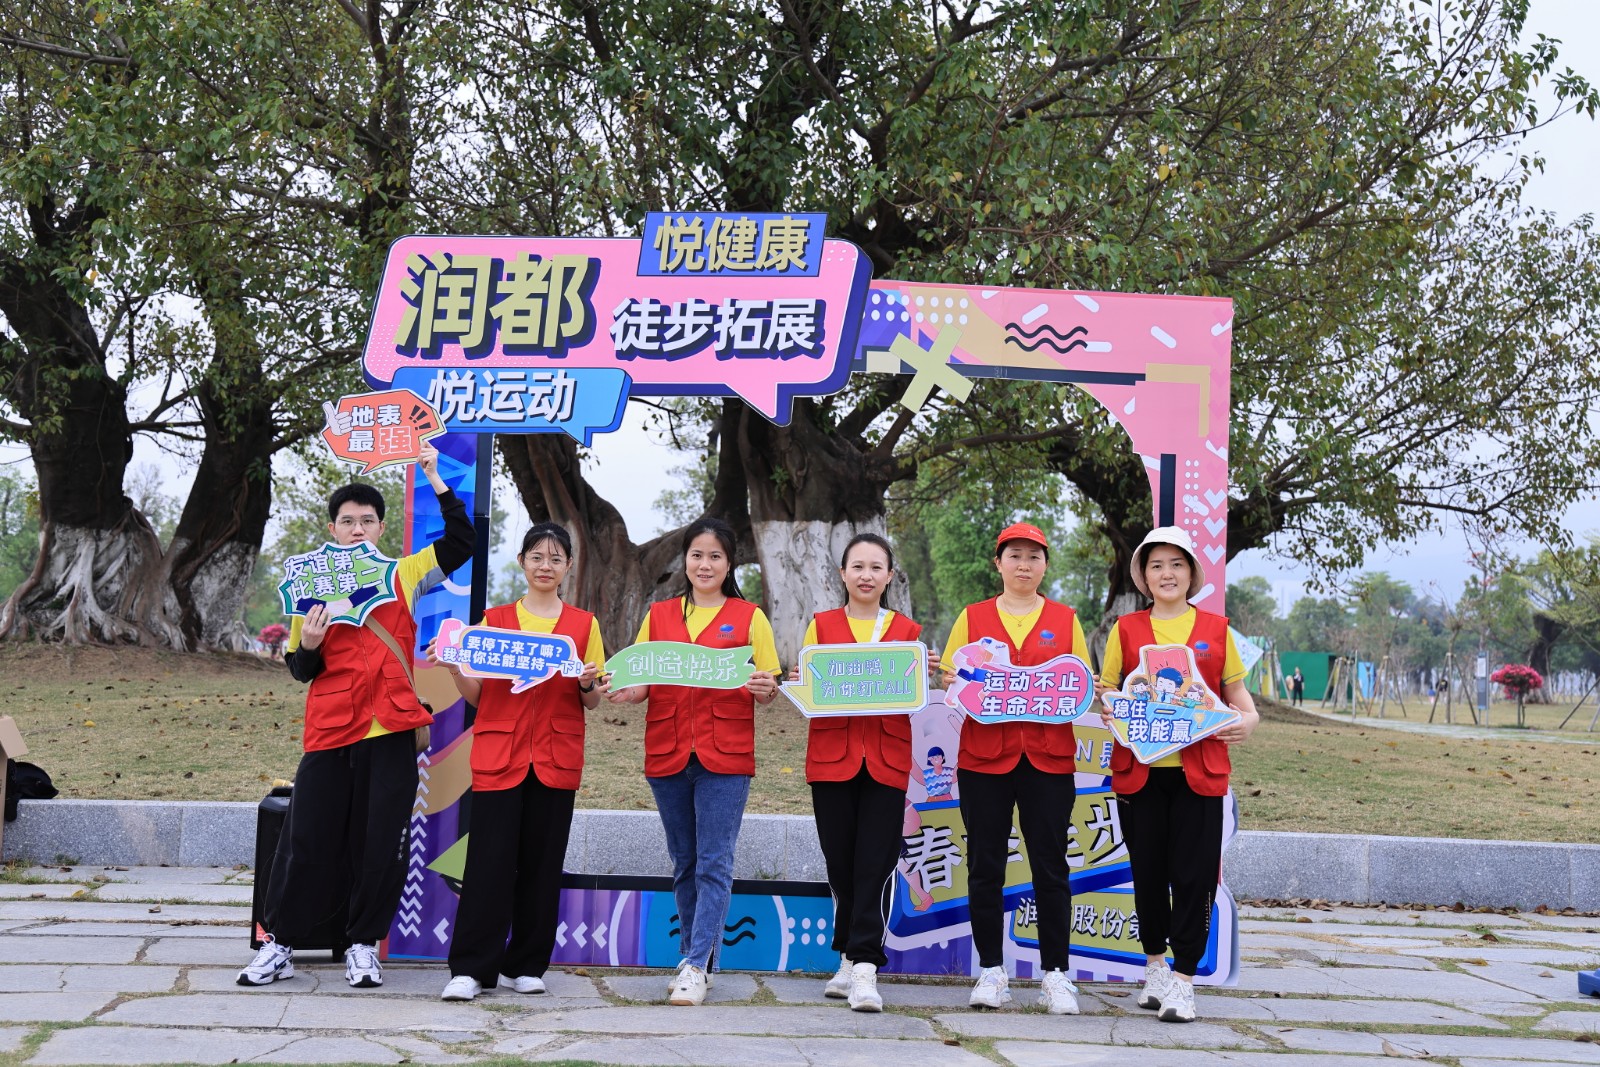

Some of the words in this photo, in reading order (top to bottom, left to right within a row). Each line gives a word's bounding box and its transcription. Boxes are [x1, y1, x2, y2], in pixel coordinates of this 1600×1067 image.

[653, 215, 811, 273] 悦健康
[393, 250, 596, 353] 润都
[610, 297, 822, 357] 徒步拓展
[427, 369, 577, 422] 悦运动
[351, 404, 401, 426] 地表
[348, 426, 412, 455] 最强
[285, 550, 377, 581] 友谊第一
[290, 567, 383, 602] 比赛第二
[443, 647, 582, 675] 我想你还能坚持一下！
[625, 650, 738, 681] 创造快乐
[984, 671, 1081, 693] 运动不止
[981, 696, 1077, 717] 生命不息
[1128, 719, 1192, 743] 我能赢
